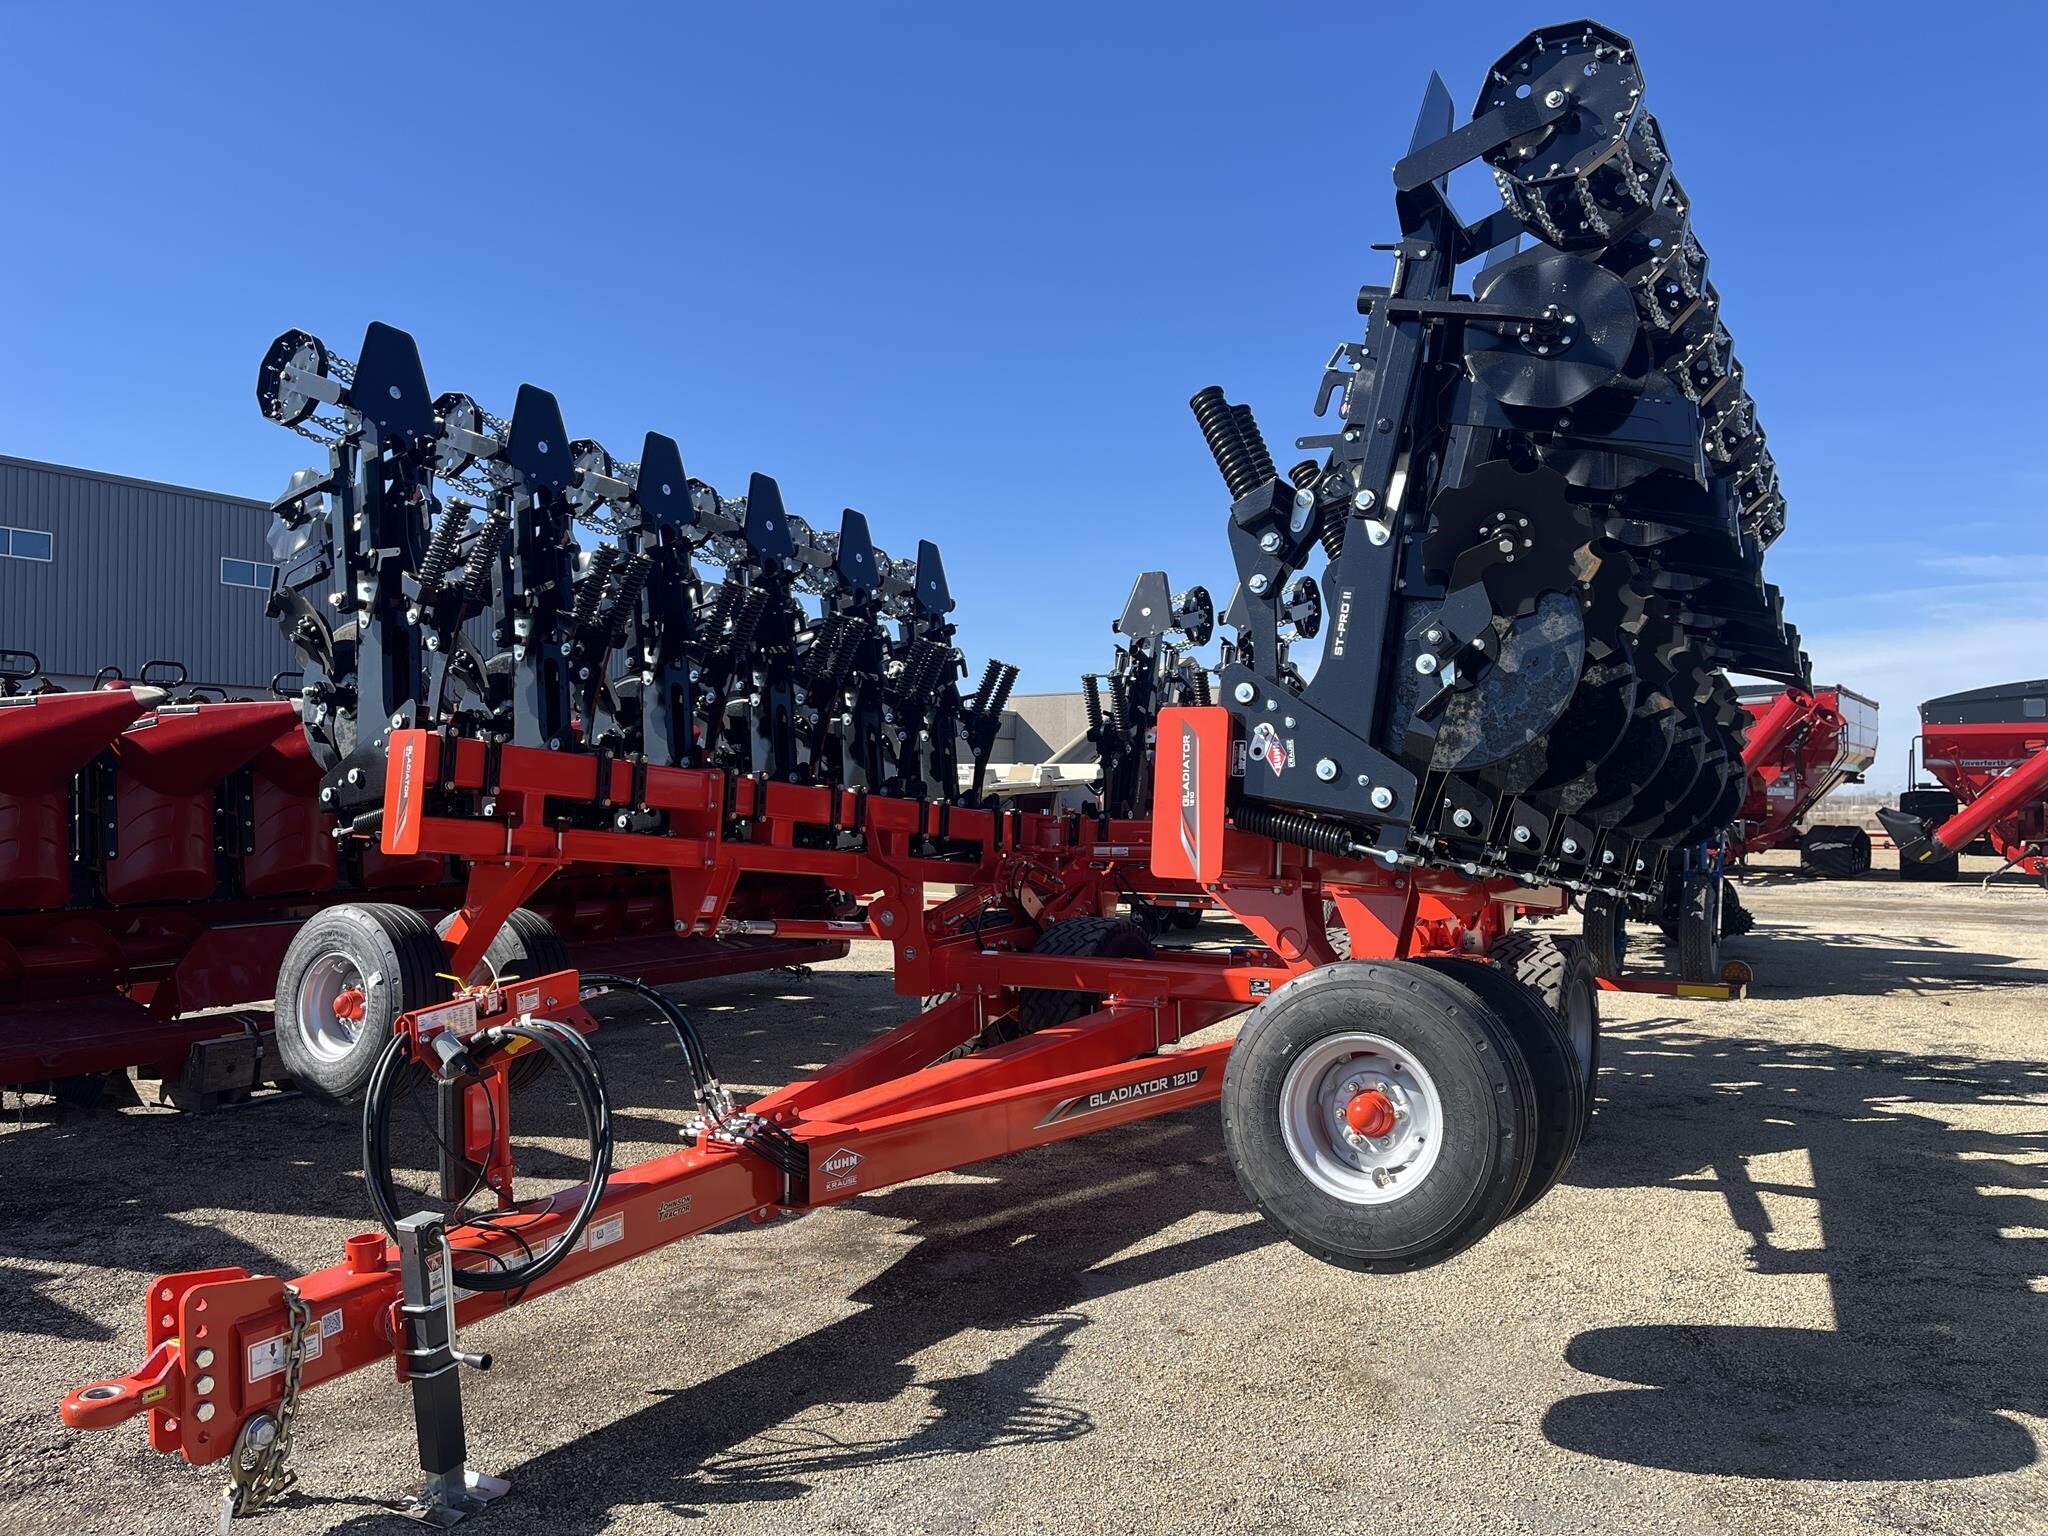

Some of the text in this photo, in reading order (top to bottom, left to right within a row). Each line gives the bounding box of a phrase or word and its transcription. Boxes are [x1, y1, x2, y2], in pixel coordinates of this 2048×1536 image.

[1333, 591, 1352, 656] ST-PRO II
[1272, 741, 1282, 768] KUHN
[403, 745, 413, 798] GLADIATOR
[1182, 734, 1191, 807] GLADIATOR
[1089, 1070, 1198, 1107] GLADIATOR 1210
[825, 1155, 857, 1172] KUHN
[826, 1177, 857, 1190] KRAUSE
[658, 1196, 691, 1212] JOHNSON
[659, 1206, 690, 1220] TRACTOR
